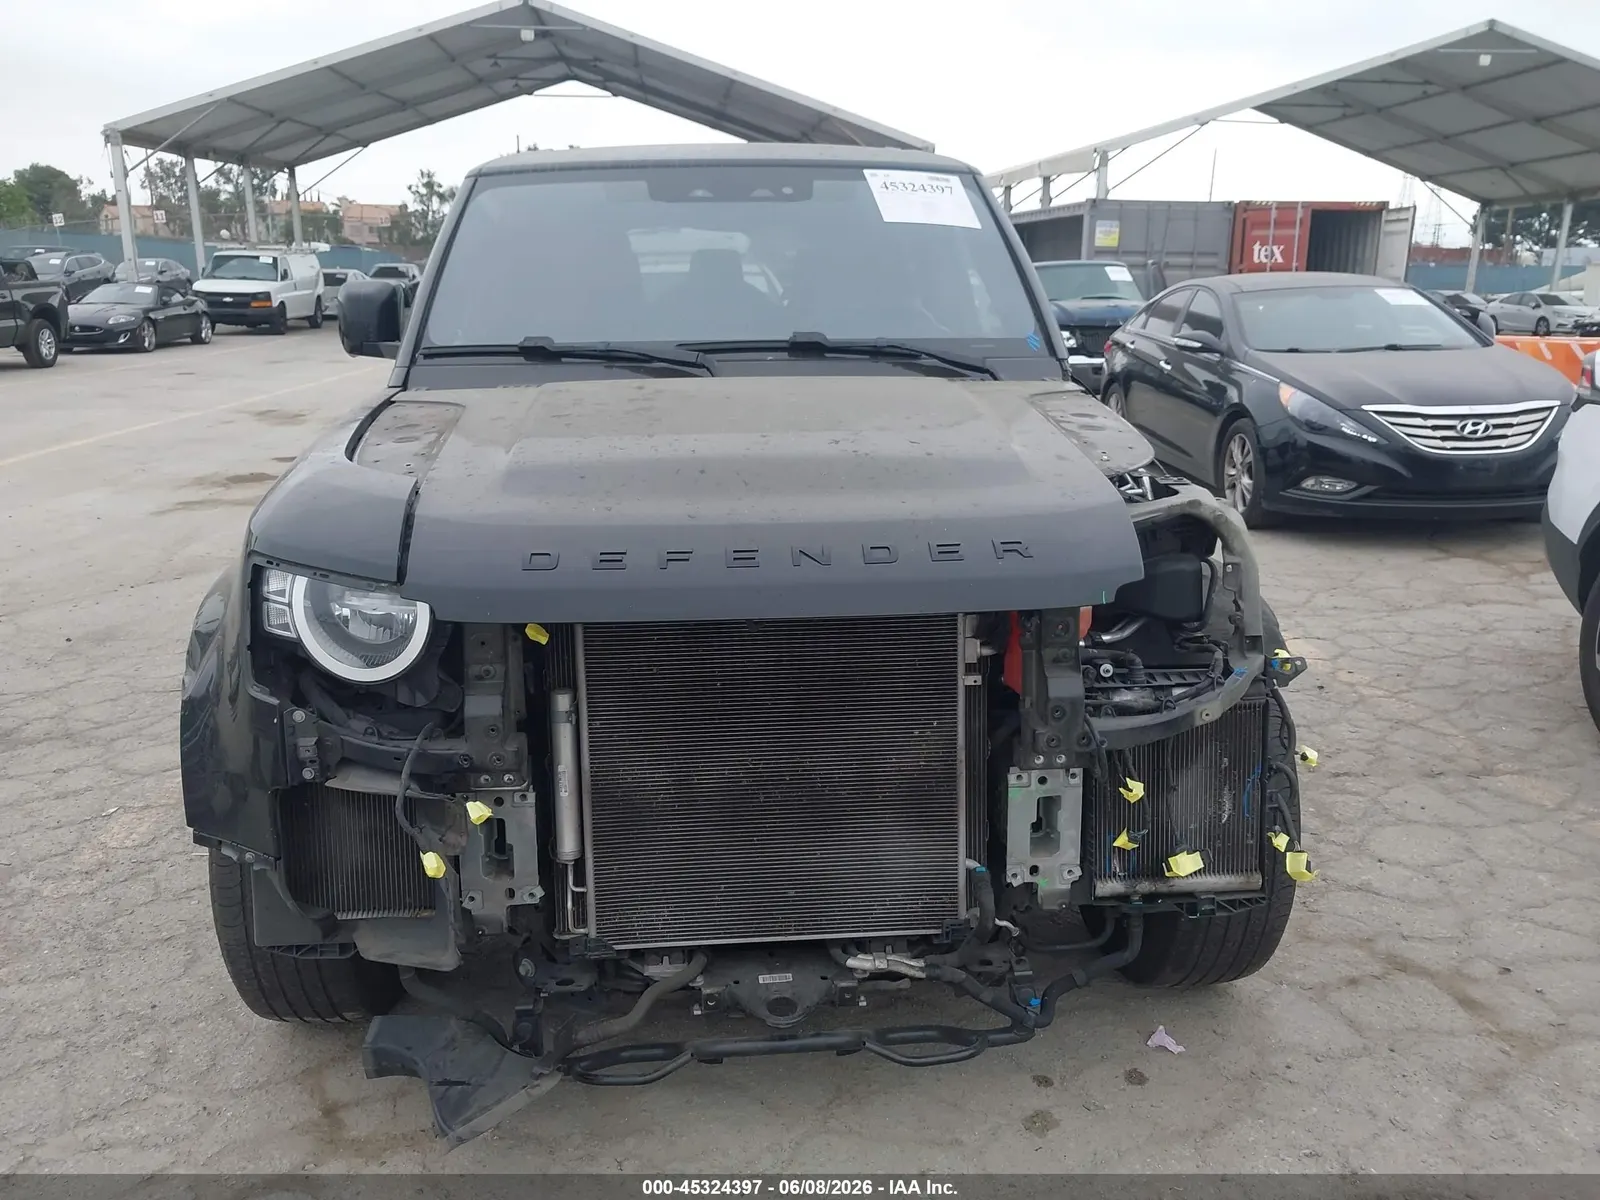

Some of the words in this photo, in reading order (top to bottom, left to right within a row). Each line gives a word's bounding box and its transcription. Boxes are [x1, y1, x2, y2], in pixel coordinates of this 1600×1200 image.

[880, 181, 953, 195] 45324397
[1252, 240, 1284, 263] tex
[521, 537, 1033, 571] DEFENDER
